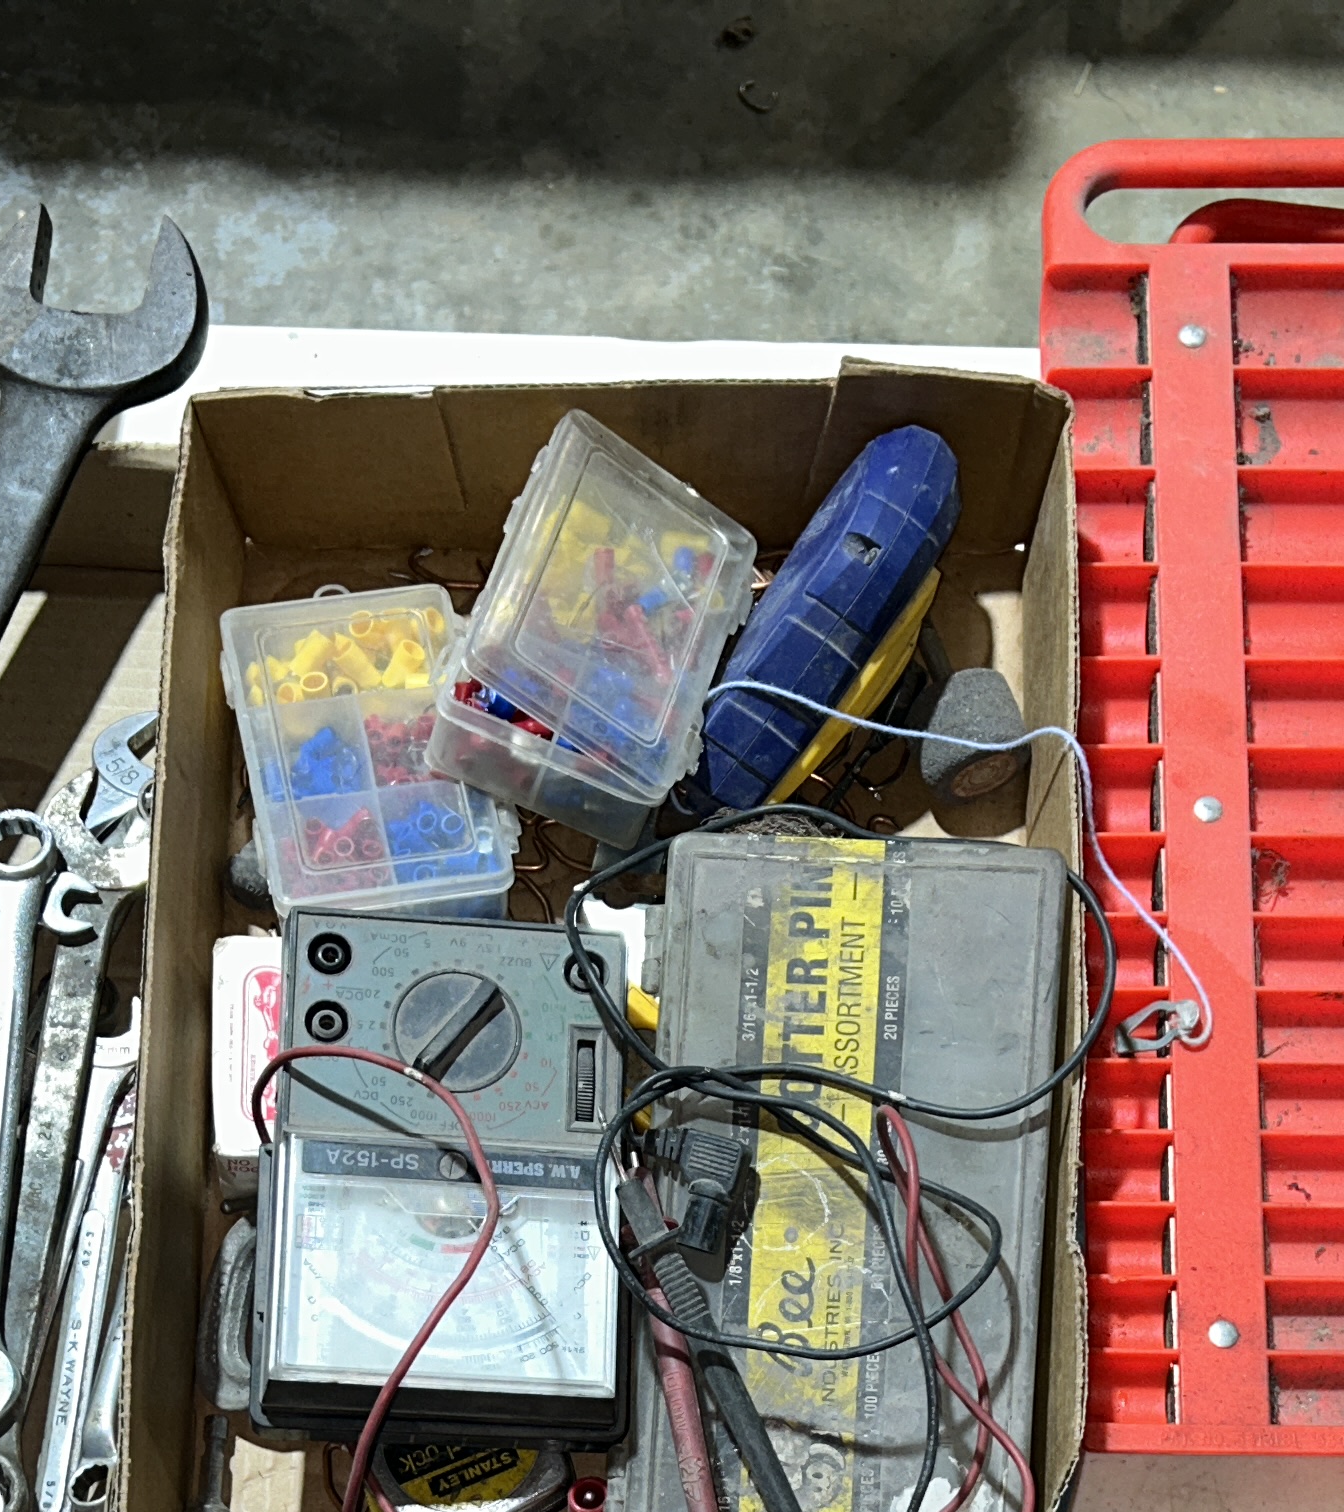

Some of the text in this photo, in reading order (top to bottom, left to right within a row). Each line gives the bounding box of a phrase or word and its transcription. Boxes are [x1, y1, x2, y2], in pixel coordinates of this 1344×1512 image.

[105, 756, 140, 786] 5/8
[787, 866, 834, 940] PIN
[394, 947, 409, 958] 50
[500, 956, 532, 967] BUZZ
[372, 966, 395, 977] 500
[834, 916, 867, 1076] SSORTMENT
[883, 975, 901, 1041] 20 PIECES
[371, 1076, 387, 1087] 50
[353, 1089, 379, 1101] DCV
[390, 1095, 414, 1107] 250
[499, 1101, 550, 1112] ACV 250
[326, 1149, 420, 1171] SP-152A
[485, 1159, 582, 1180] A.W. SPERR
[756, 1257, 816, 1378] Bee
[54, 1318, 83, 1427] S-K WAYNE
[864, 1396, 878, 1419] 100
[437, 1451, 514, 1493] STANLEY
